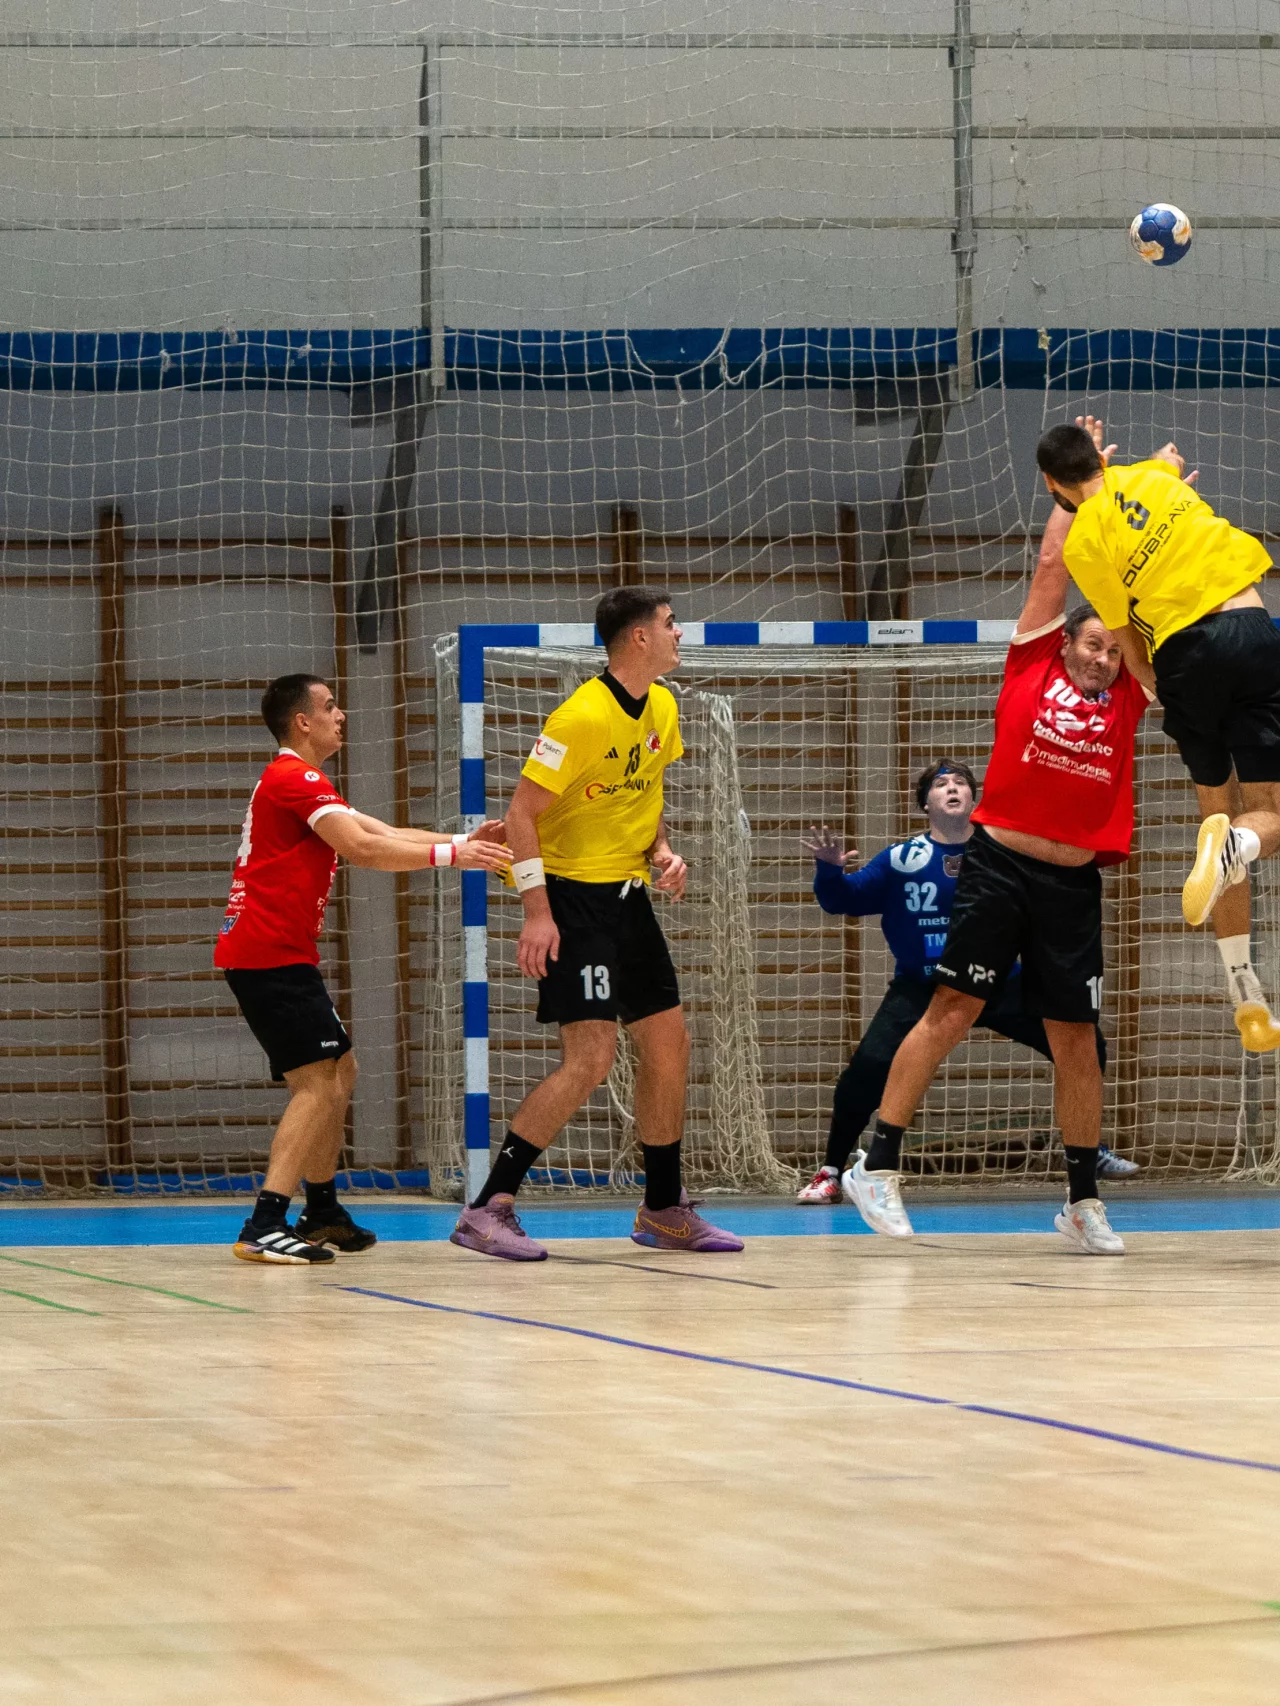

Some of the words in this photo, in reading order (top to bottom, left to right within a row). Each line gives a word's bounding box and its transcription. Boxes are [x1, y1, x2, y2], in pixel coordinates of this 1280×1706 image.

[877, 627, 914, 635] elan
[624, 743, 641, 777] 13
[904, 881, 938, 912] 32
[918, 916, 950, 926] met
[580, 964, 611, 1000] 13
